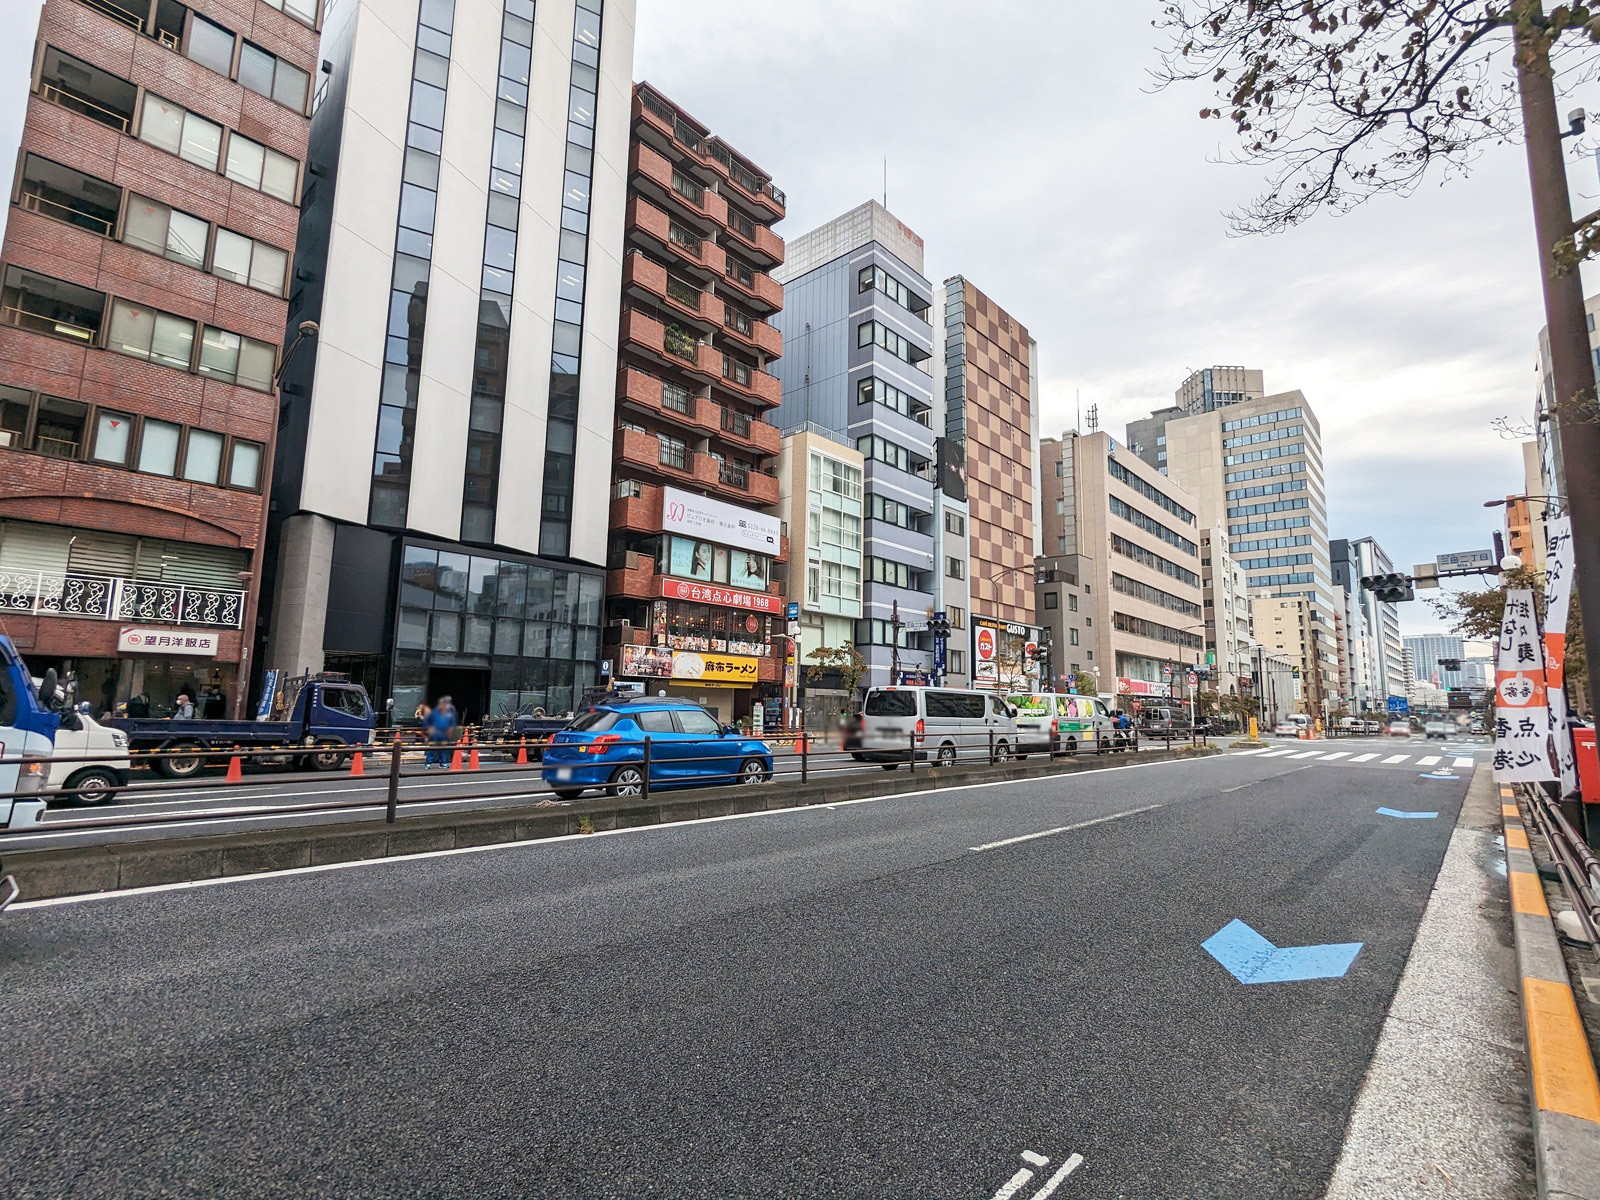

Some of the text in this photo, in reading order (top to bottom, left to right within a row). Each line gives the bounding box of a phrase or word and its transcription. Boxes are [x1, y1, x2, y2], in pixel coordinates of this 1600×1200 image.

[1441, 553, 1488, 565] 三田二丁目
[691, 586, 769, 608] 台湾点心劇場 1968
[1007, 624, 1026, 636] GUSTO
[144, 636, 211, 649] 望月洋服店
[980, 642, 992, 651] ガスト
[704, 661, 757, 674] 麻布ラーメン
